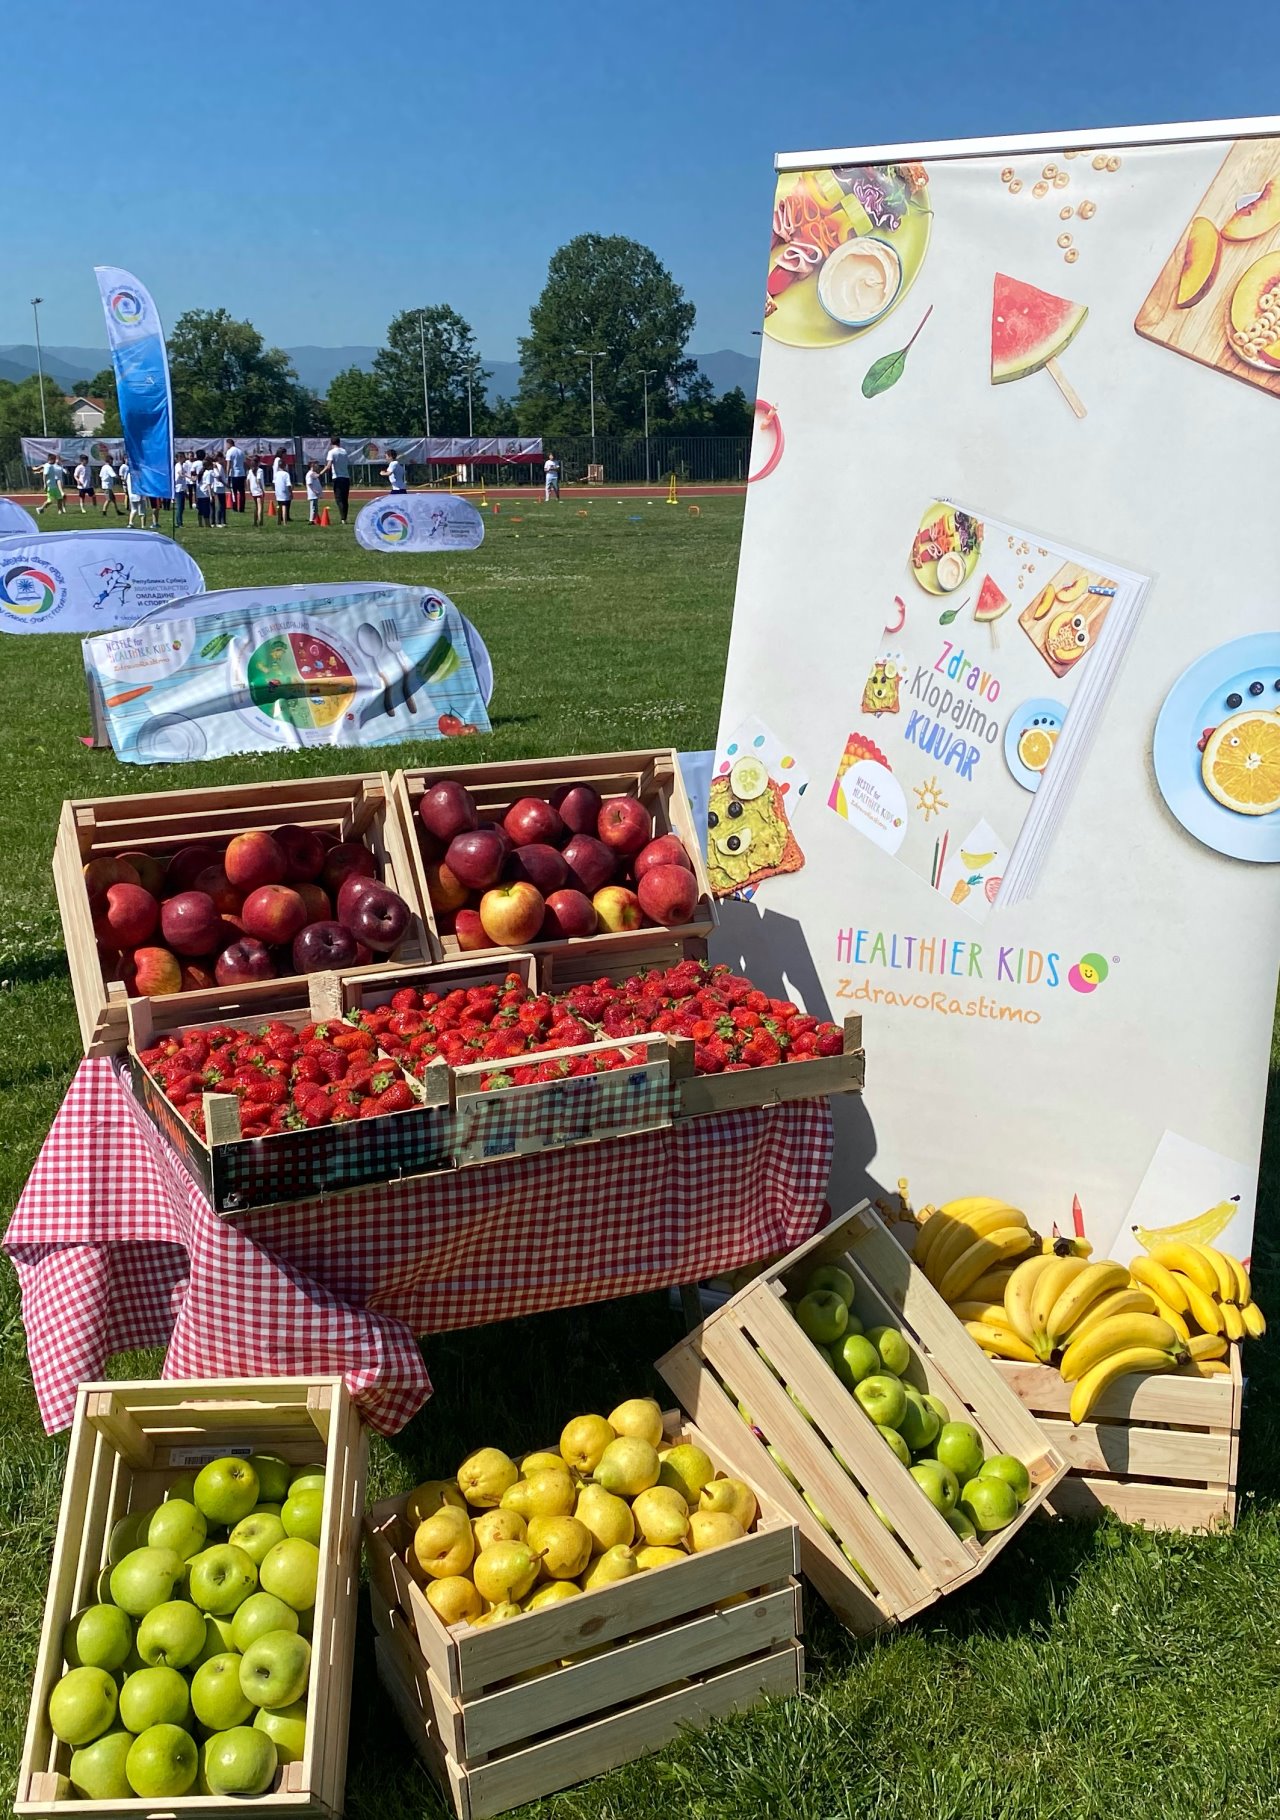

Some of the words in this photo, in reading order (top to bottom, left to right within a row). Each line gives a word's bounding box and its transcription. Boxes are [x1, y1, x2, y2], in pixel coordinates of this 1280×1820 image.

[153, 643, 172, 655] KIDS
[934, 640, 1000, 702] Zdravo
[910, 666, 998, 743] Klopajmo
[904, 709, 980, 781] KUVAR
[837, 927, 984, 979] HEALTHIER
[997, 947, 1060, 988] KIDS
[835, 978, 1042, 1024] ZdravoRastimo
